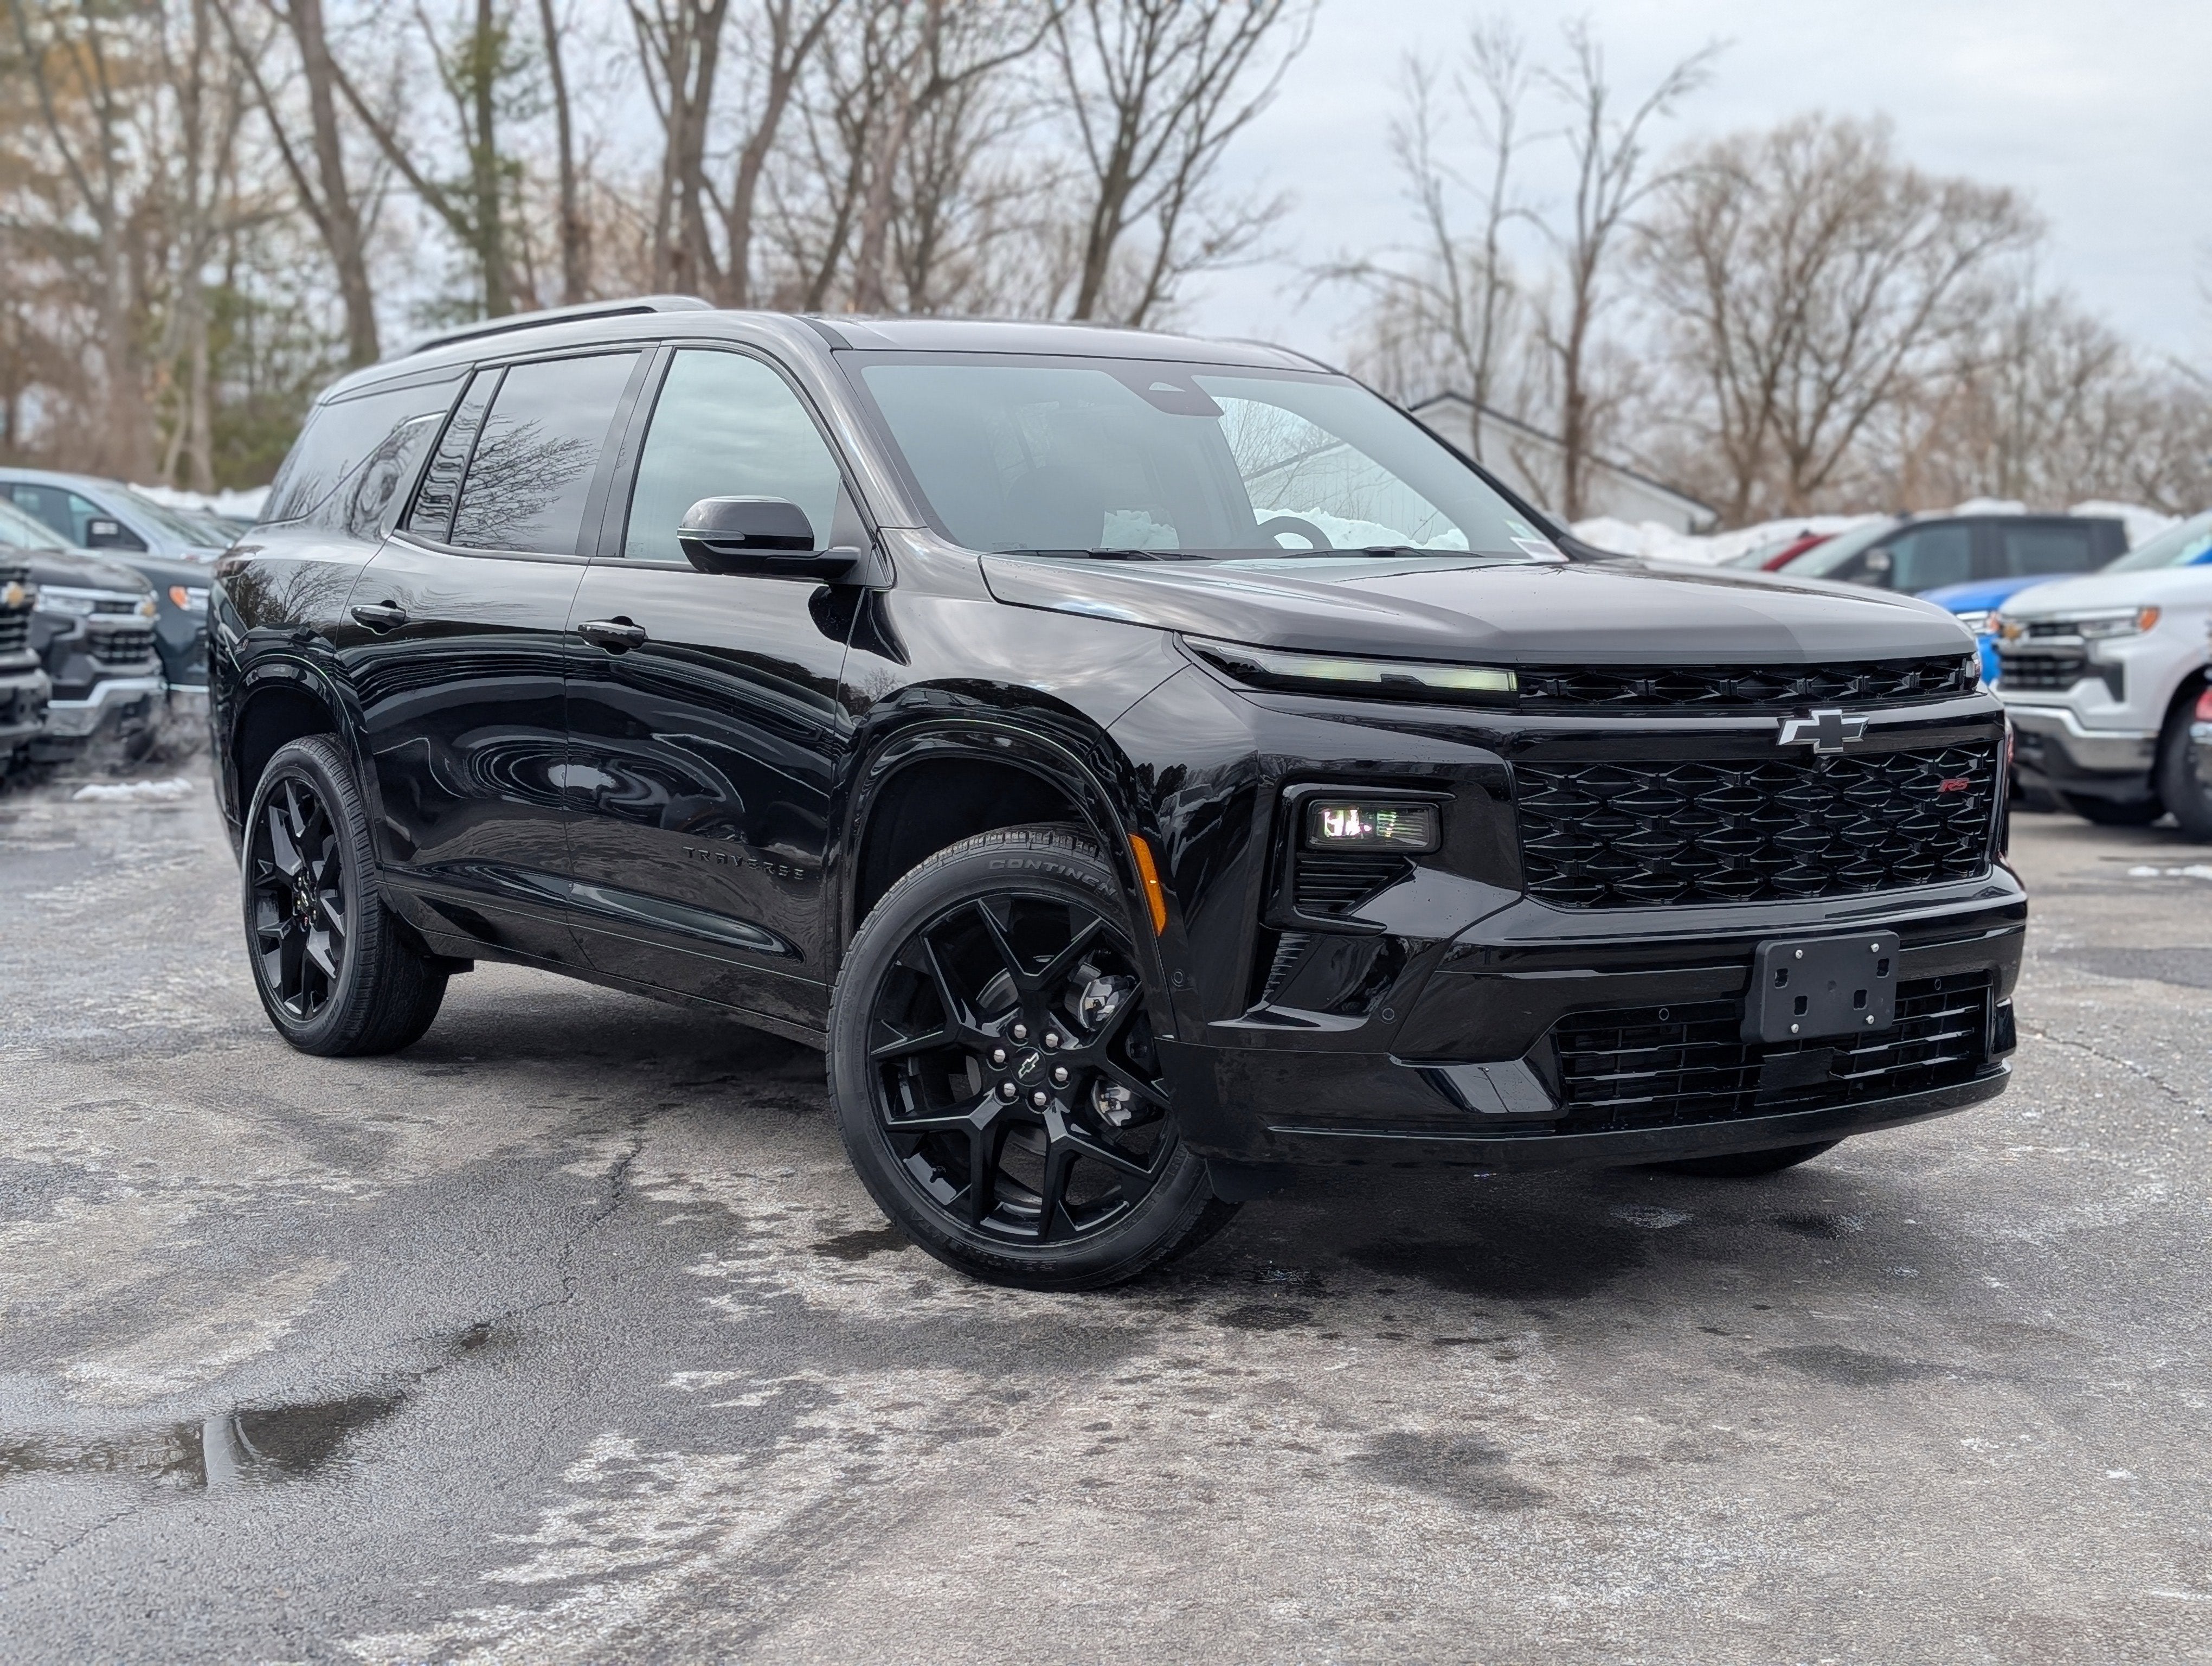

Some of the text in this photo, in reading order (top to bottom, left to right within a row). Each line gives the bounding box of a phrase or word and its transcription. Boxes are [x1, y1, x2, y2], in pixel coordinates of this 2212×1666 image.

[1937, 777, 1970, 792] RS
[682, 846, 804, 880] TRAVERSE
[989, 857, 1118, 897] CONTINEN
